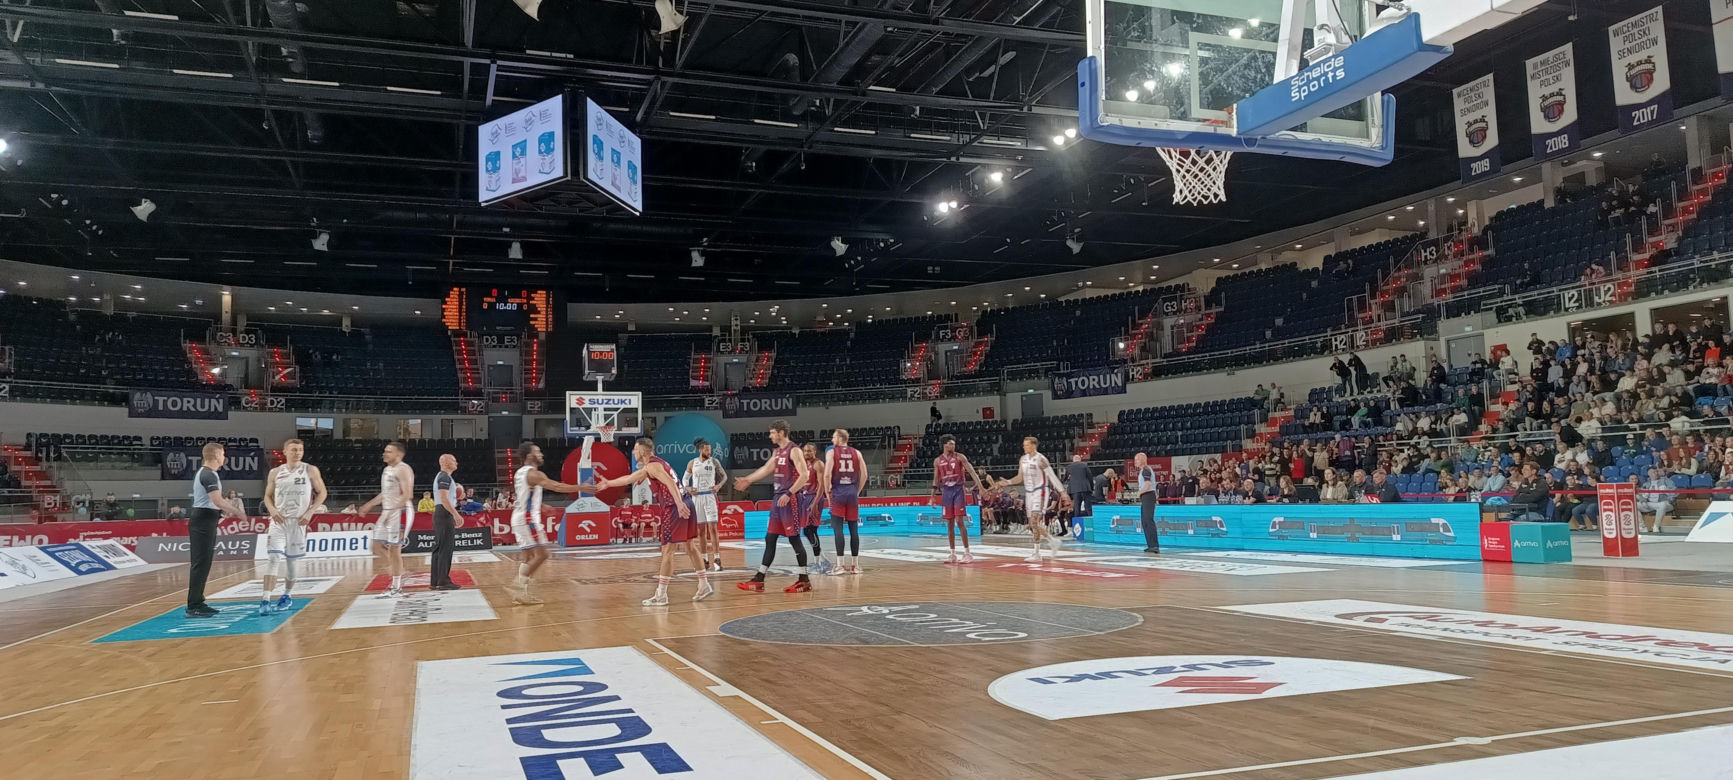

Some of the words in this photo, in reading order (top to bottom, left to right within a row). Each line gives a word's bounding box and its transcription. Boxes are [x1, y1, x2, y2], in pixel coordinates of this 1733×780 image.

[1612, 11, 1660, 38] WICEMISTRZ
[1622, 26, 1651, 46] POLSKI
[1539, 50, 1567, 68] MIEJSCE
[1291, 55, 1345, 90] Schelde
[1530, 59, 1571, 81] MISTRZOSTW
[1539, 72, 1562, 88] POLSKI
[1456, 79, 1490, 98] WICEMISTRZ
[1463, 91, 1484, 106] POLSKI
[1632, 104, 1658, 126] 2017
[1545, 134, 1569, 153] 2018
[1470, 158, 1490, 176] 2019
[1421, 246, 1436, 262] H3
[1564, 290, 1578, 308] I2
[1595, 284, 1615, 304] J2
[1163, 301, 1178, 313] G3
[216, 332, 233, 343] C3
[240, 334, 256, 344] D3
[483, 335, 498, 345] D3
[504, 336, 518, 345] E3
[940, 329, 951, 340] F3
[1332, 334, 1347, 350] H2
[720, 343, 732, 351] E3
[738, 342, 750, 351] F3
[1129, 366, 1143, 379] H2
[907, 387, 920, 398] F2
[154, 393, 224, 412] TORUŃ
[268, 397, 285, 409] D2
[527, 400, 542, 411] E2
[588, 398, 632, 406] SUZUKI
[705, 397, 719, 407] E2
[740, 394, 793, 411] TORUŃ
[655, 440, 697, 455] arriva
[838, 459, 855, 473] 11
[294, 477, 306, 485] 21
[869, 475, 881, 487] F1
[44, 495, 60, 508] B1
[305, 535, 369, 553] nomet
[1388, 622, 1550, 642] TRANSPORT
[1551, 640, 1733, 665] SPEDYCJA
[1027, 658, 1276, 685] SUZUKI
